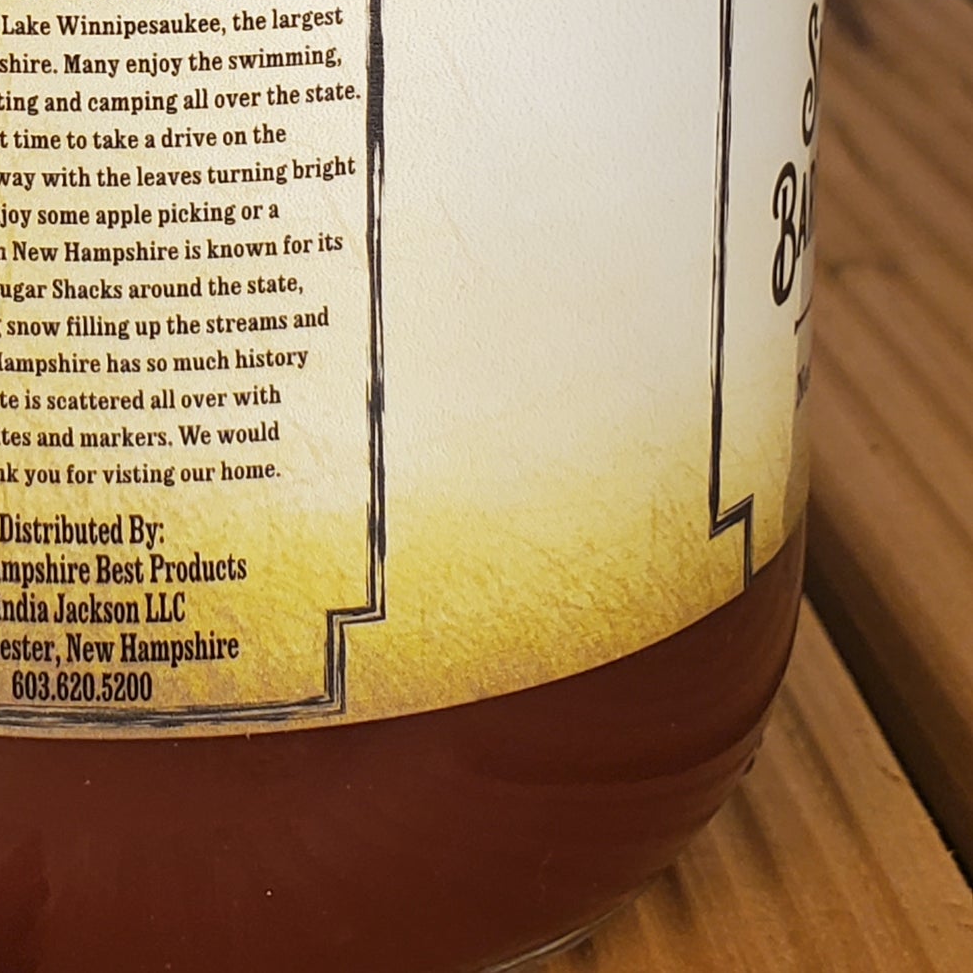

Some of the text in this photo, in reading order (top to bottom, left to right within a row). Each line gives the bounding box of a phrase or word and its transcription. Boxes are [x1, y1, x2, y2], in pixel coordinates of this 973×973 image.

[1, 14, 51, 36] Lake
[56, 12, 227, 40] Winnipesaukee,
[232, 10, 267, 32] the
[271, 6, 344, 32] largest
[63, 53, 120, 79] Many
[125, 52, 183, 78] enjoy
[188, 50, 223, 72] the
[228, 44, 342, 71] swimming,
[44, 90, 83, 113] and
[87, 90, 179, 116] camping
[183, 87, 209, 111] all
[214, 91, 262, 109] over
[266, 84, 301, 106] the
[305, 82, 361, 104] state.
[40, 166, 91, 188] with
[96, 166, 131, 188] the
[136, 165, 202, 187] leaves
[207, 161, 288, 186] turning
[291, 155, 356, 182] bright
[37, 209, 90, 226] some
[95, 203, 153, 230] apple
[157, 201, 237, 229] picking
[241, 204, 264, 221] or
[268, 203, 280, 219] a
[11, 240, 59, 262] New
[63, 240, 179, 267] Hampshire
[184, 239, 202, 261] is
[206, 238, 278, 260] known
[283, 234, 314, 255] for
[317, 232, 344, 253] its
[52, 278, 123, 300] Shacks
[128, 276, 203, 300] around
[207, 275, 242, 297] the
[246, 274, 304, 295] state,
[106, 352, 141, 374] has
[146, 357, 168, 373] so
[172, 349, 230, 372] much
[234, 348, 309, 370] history
[24, 388, 42, 411] is
[46, 389, 145, 411] scattered
[150, 388, 176, 410] all
[180, 392, 228, 409] over
[232, 383, 282, 407] with
[36, 426, 75, 448] and
[79, 426, 173, 448] markers.
[177, 424, 212, 446] We
[216, 420, 280, 445] would
[23, 468, 62, 488] you
[66, 463, 98, 485] for
[101, 463, 176, 488] visting
[180, 466, 216, 483] our
[220, 460, 281, 482] home.
[128, 513, 165, 551] By:
[95, 553, 145, 585] Best
[149, 551, 248, 584] Products
[52, 592, 141, 625] Jackson
[144, 590, 186, 624] LLC
[65, 632, 116, 664] New
[119, 629, 240, 669] Hampshire
[11, 669, 153, 703] 603.620.5200
